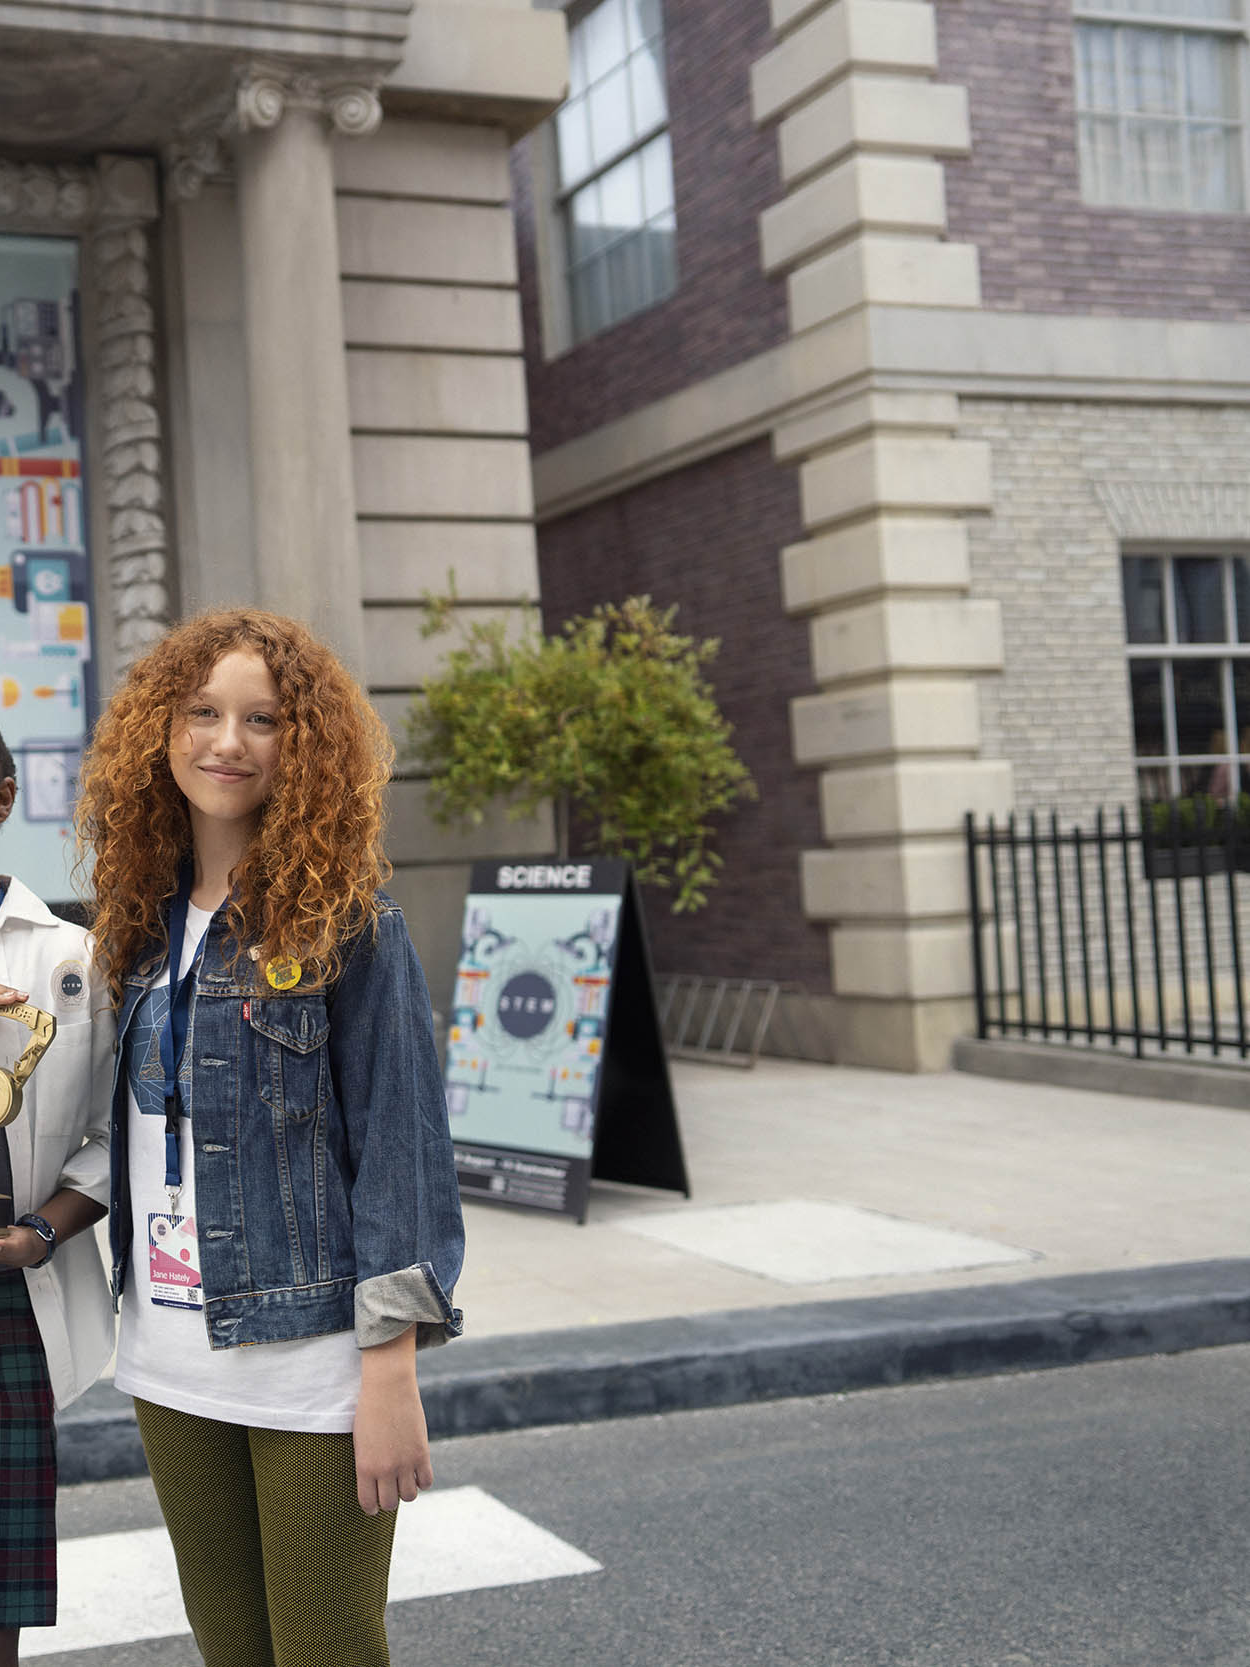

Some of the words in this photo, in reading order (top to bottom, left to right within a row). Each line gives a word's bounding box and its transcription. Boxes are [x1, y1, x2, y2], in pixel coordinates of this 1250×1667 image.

[497, 865, 592, 889] SCIENCE
[499, 995, 554, 1014] STEM
[152, 1270, 167, 1279] Jane
[169, 1272, 190, 1283] Hately
